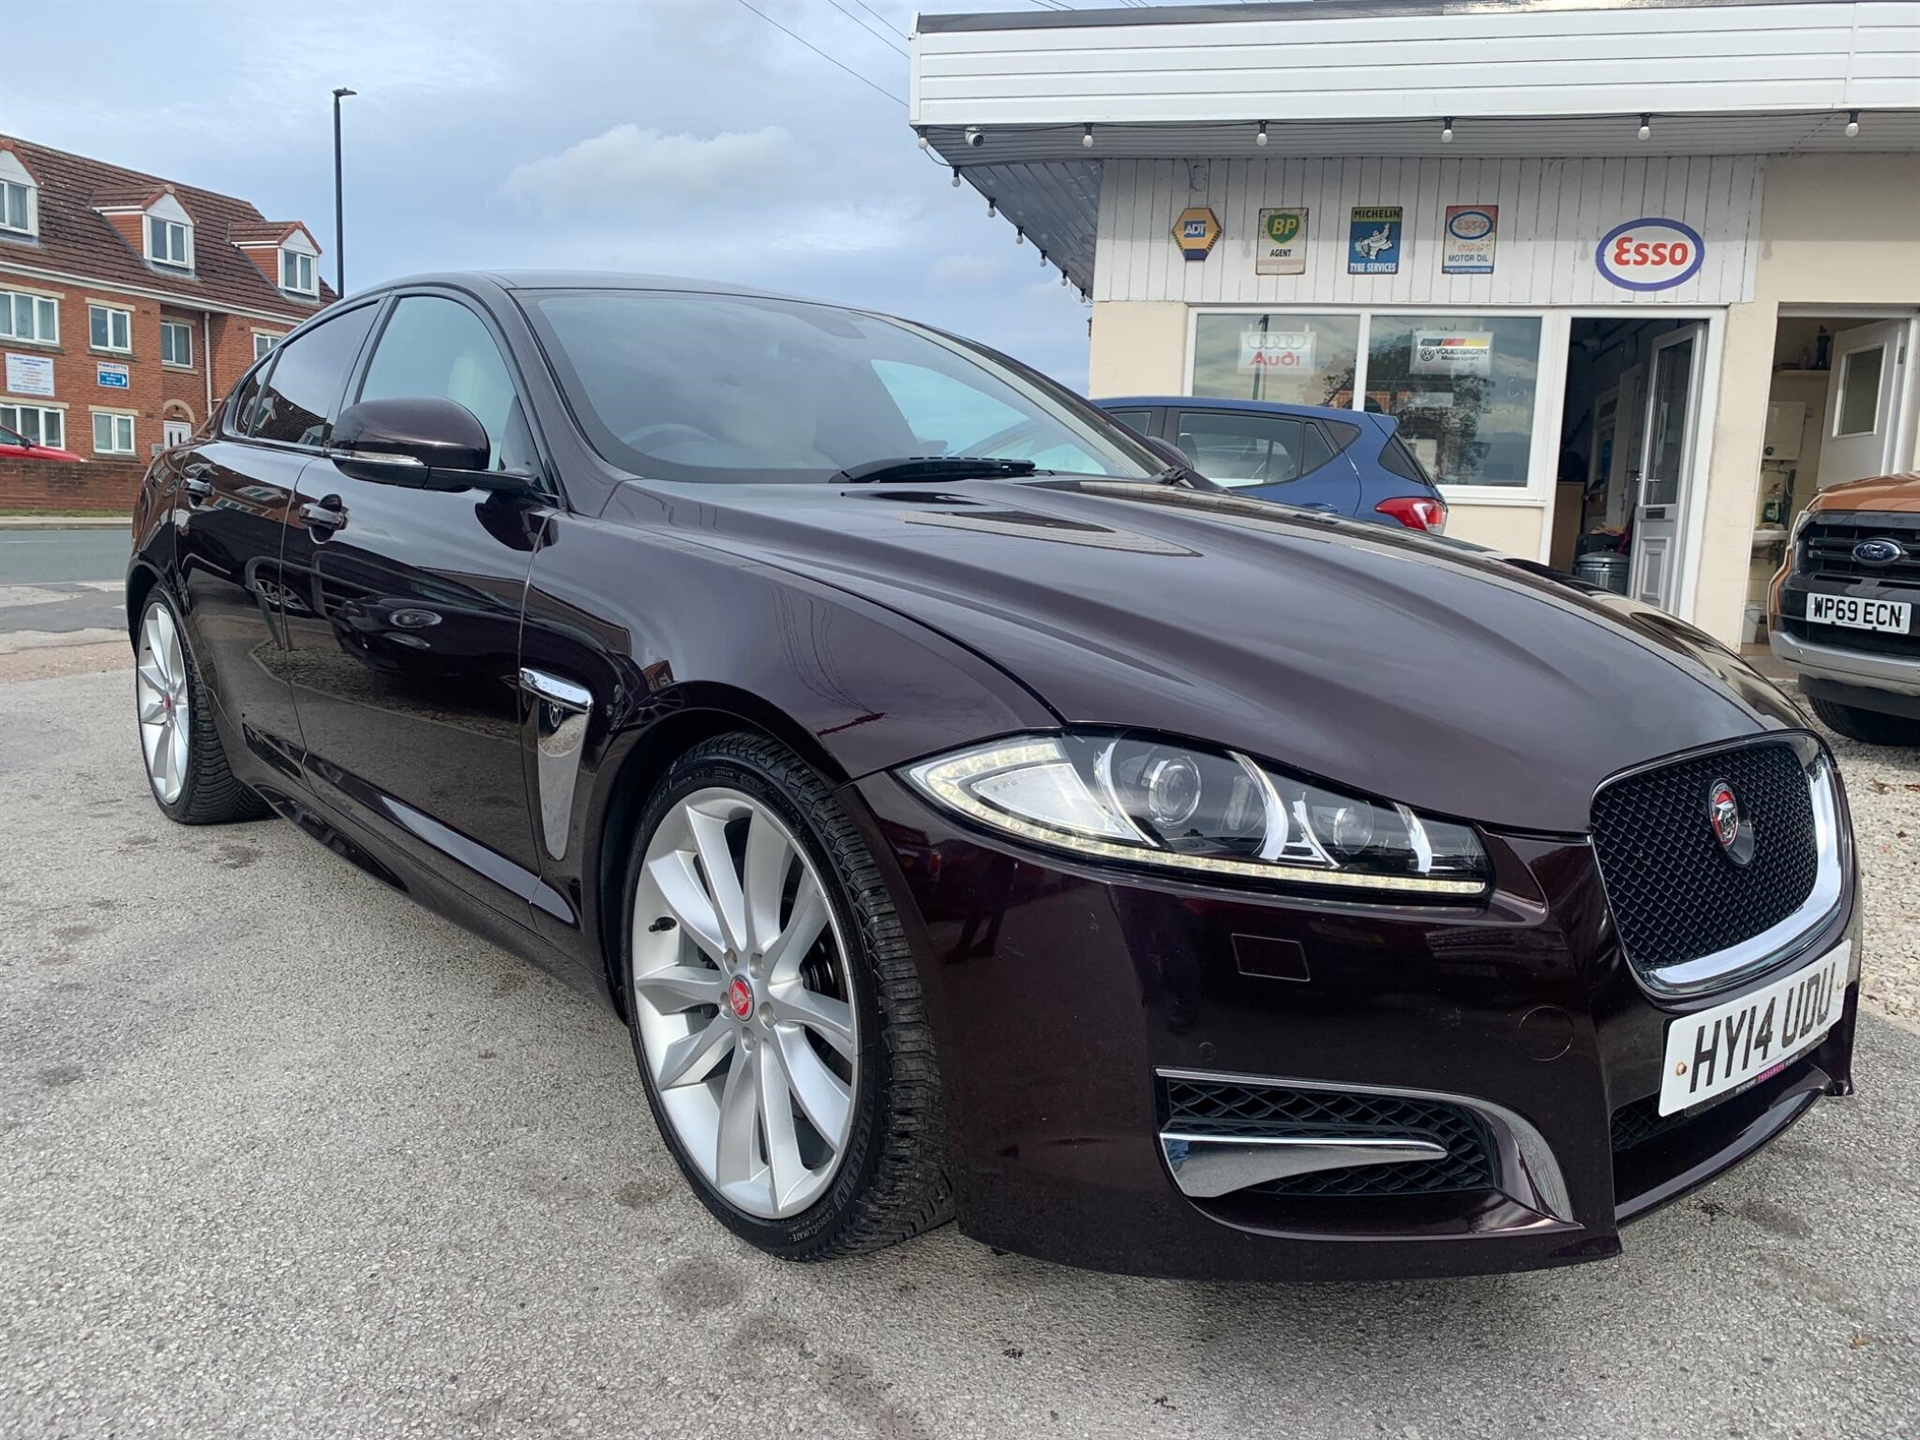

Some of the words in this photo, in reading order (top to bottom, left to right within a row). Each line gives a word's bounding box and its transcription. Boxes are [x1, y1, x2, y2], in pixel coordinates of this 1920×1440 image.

[1354, 209, 1401, 219] MICHELIN
[1183, 223, 1208, 235] ADT
[1271, 218, 1297, 235] BP
[1269, 249, 1292, 257] AGENT
[1448, 254, 1475, 262] MOTOR
[1476, 254, 1489, 262] OIL
[1350, 263, 1365, 272] TYRE
[1366, 263, 1396, 273] SERVICES
[1436, 347, 1486, 355] VOLKSWAGEN
[1813, 596, 1858, 622] WP69
[1863, 602, 1902, 628] ECN
[1689, 996, 1776, 1093] HY14
[1781, 962, 1836, 1049] UDU
